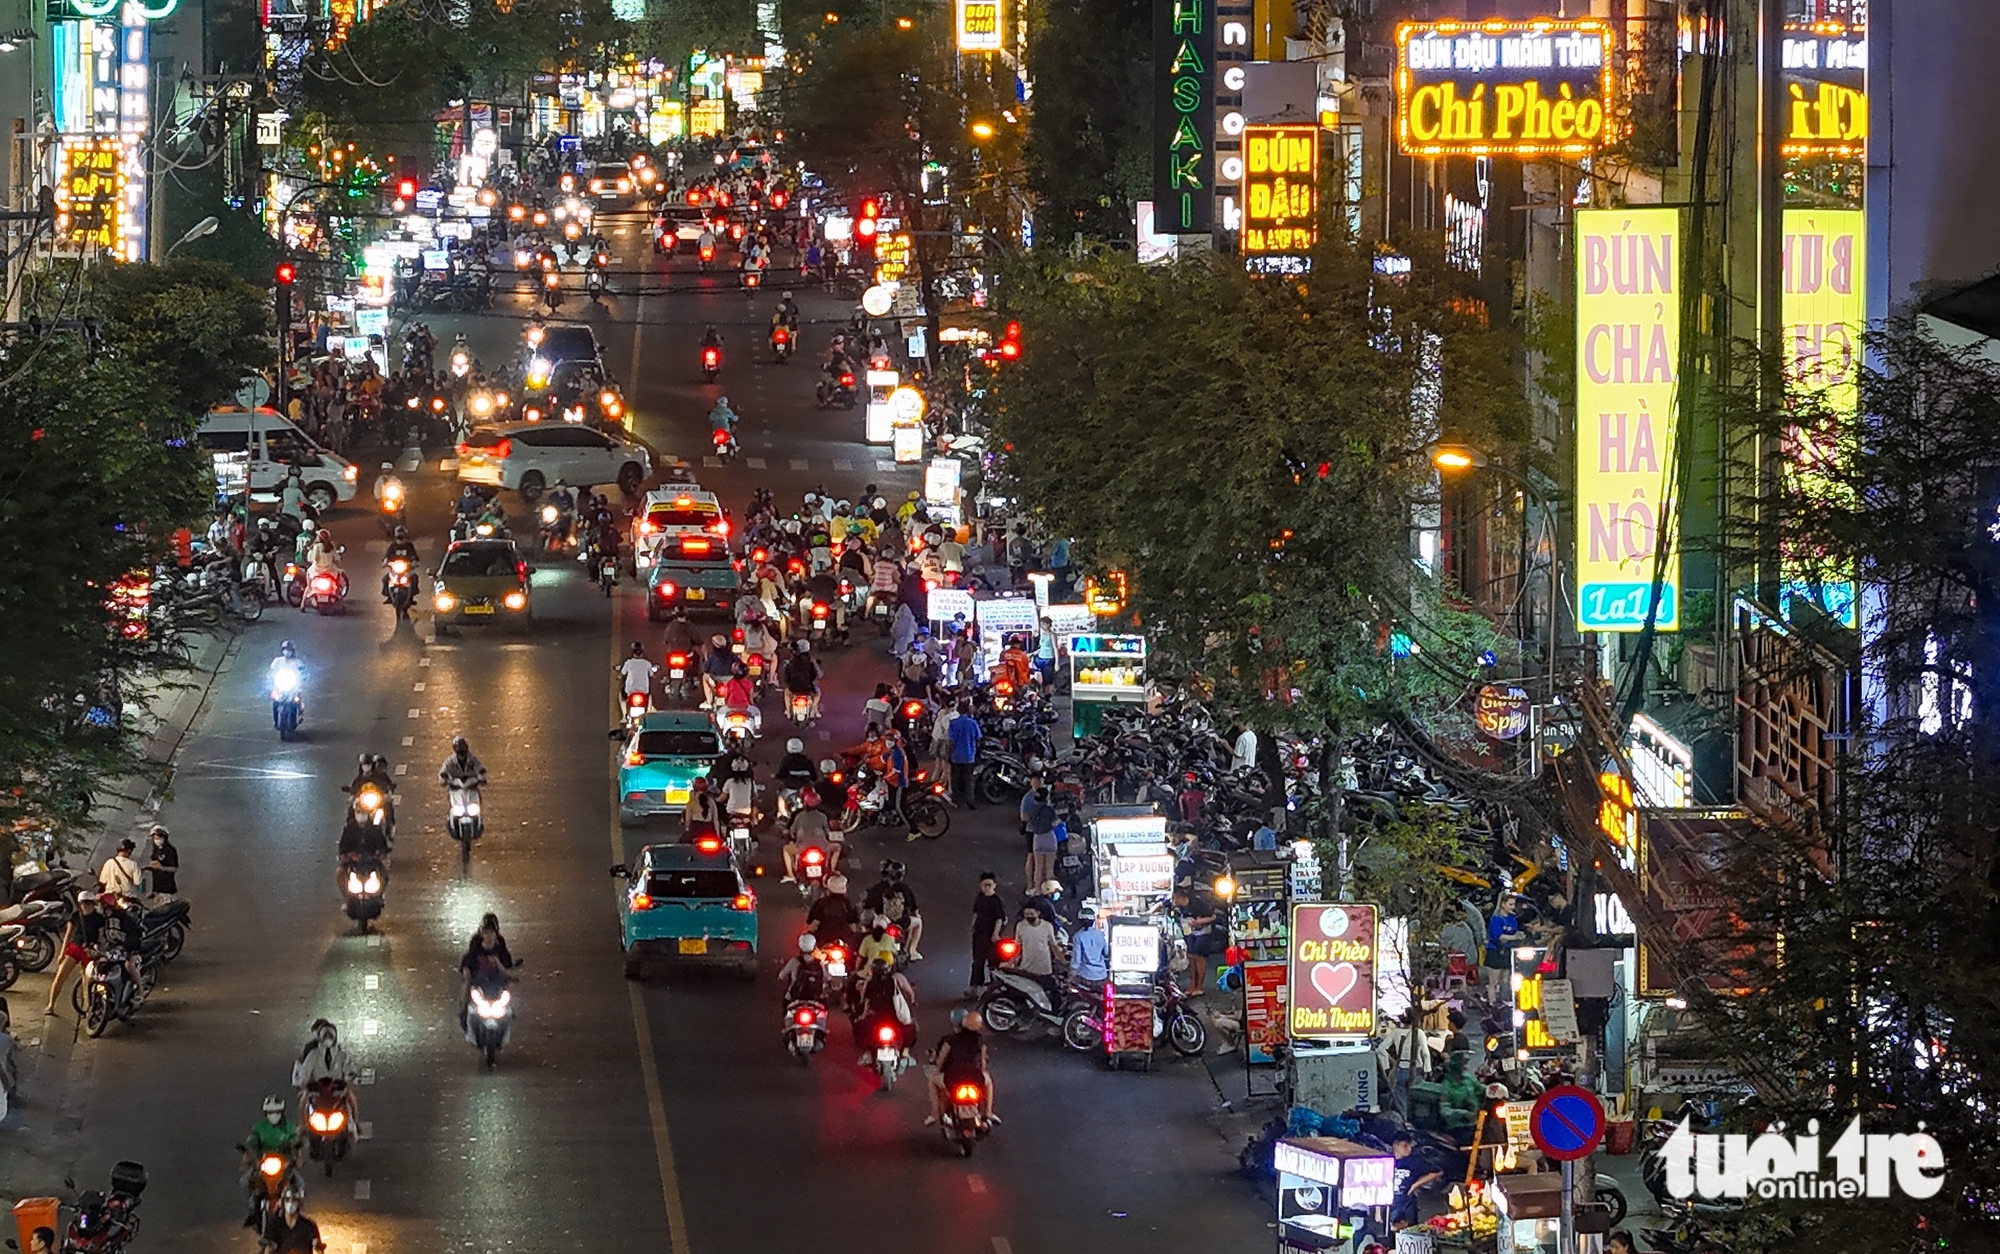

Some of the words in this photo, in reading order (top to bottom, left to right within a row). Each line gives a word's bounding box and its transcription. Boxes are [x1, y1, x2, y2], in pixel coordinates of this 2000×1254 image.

[1409, 30, 1451, 69] BÚN
[1453, 32, 1498, 72] ĐẬU
[1501, 30, 1551, 68] MẮM
[1555, 31, 1602, 67] TÔM
[1170, 0, 1204, 228] HASAKI
[1410, 82, 1484, 140] Chí
[1493, 81, 1602, 139] Phèo
[1248, 131, 1312, 172] BÚN
[1250, 177, 1310, 219] ĐẬU
[1584, 220, 1672, 295] BÚN
[1584, 302, 1673, 384] CHẢ
[1598, 398, 1659, 473] HÀ
[1299, 940, 1328, 961] Chí
[1329, 940, 1370, 961] Phèo
[1295, 1007, 1328, 1028] Bình
[1329, 1007, 1371, 1031] Thạnh
